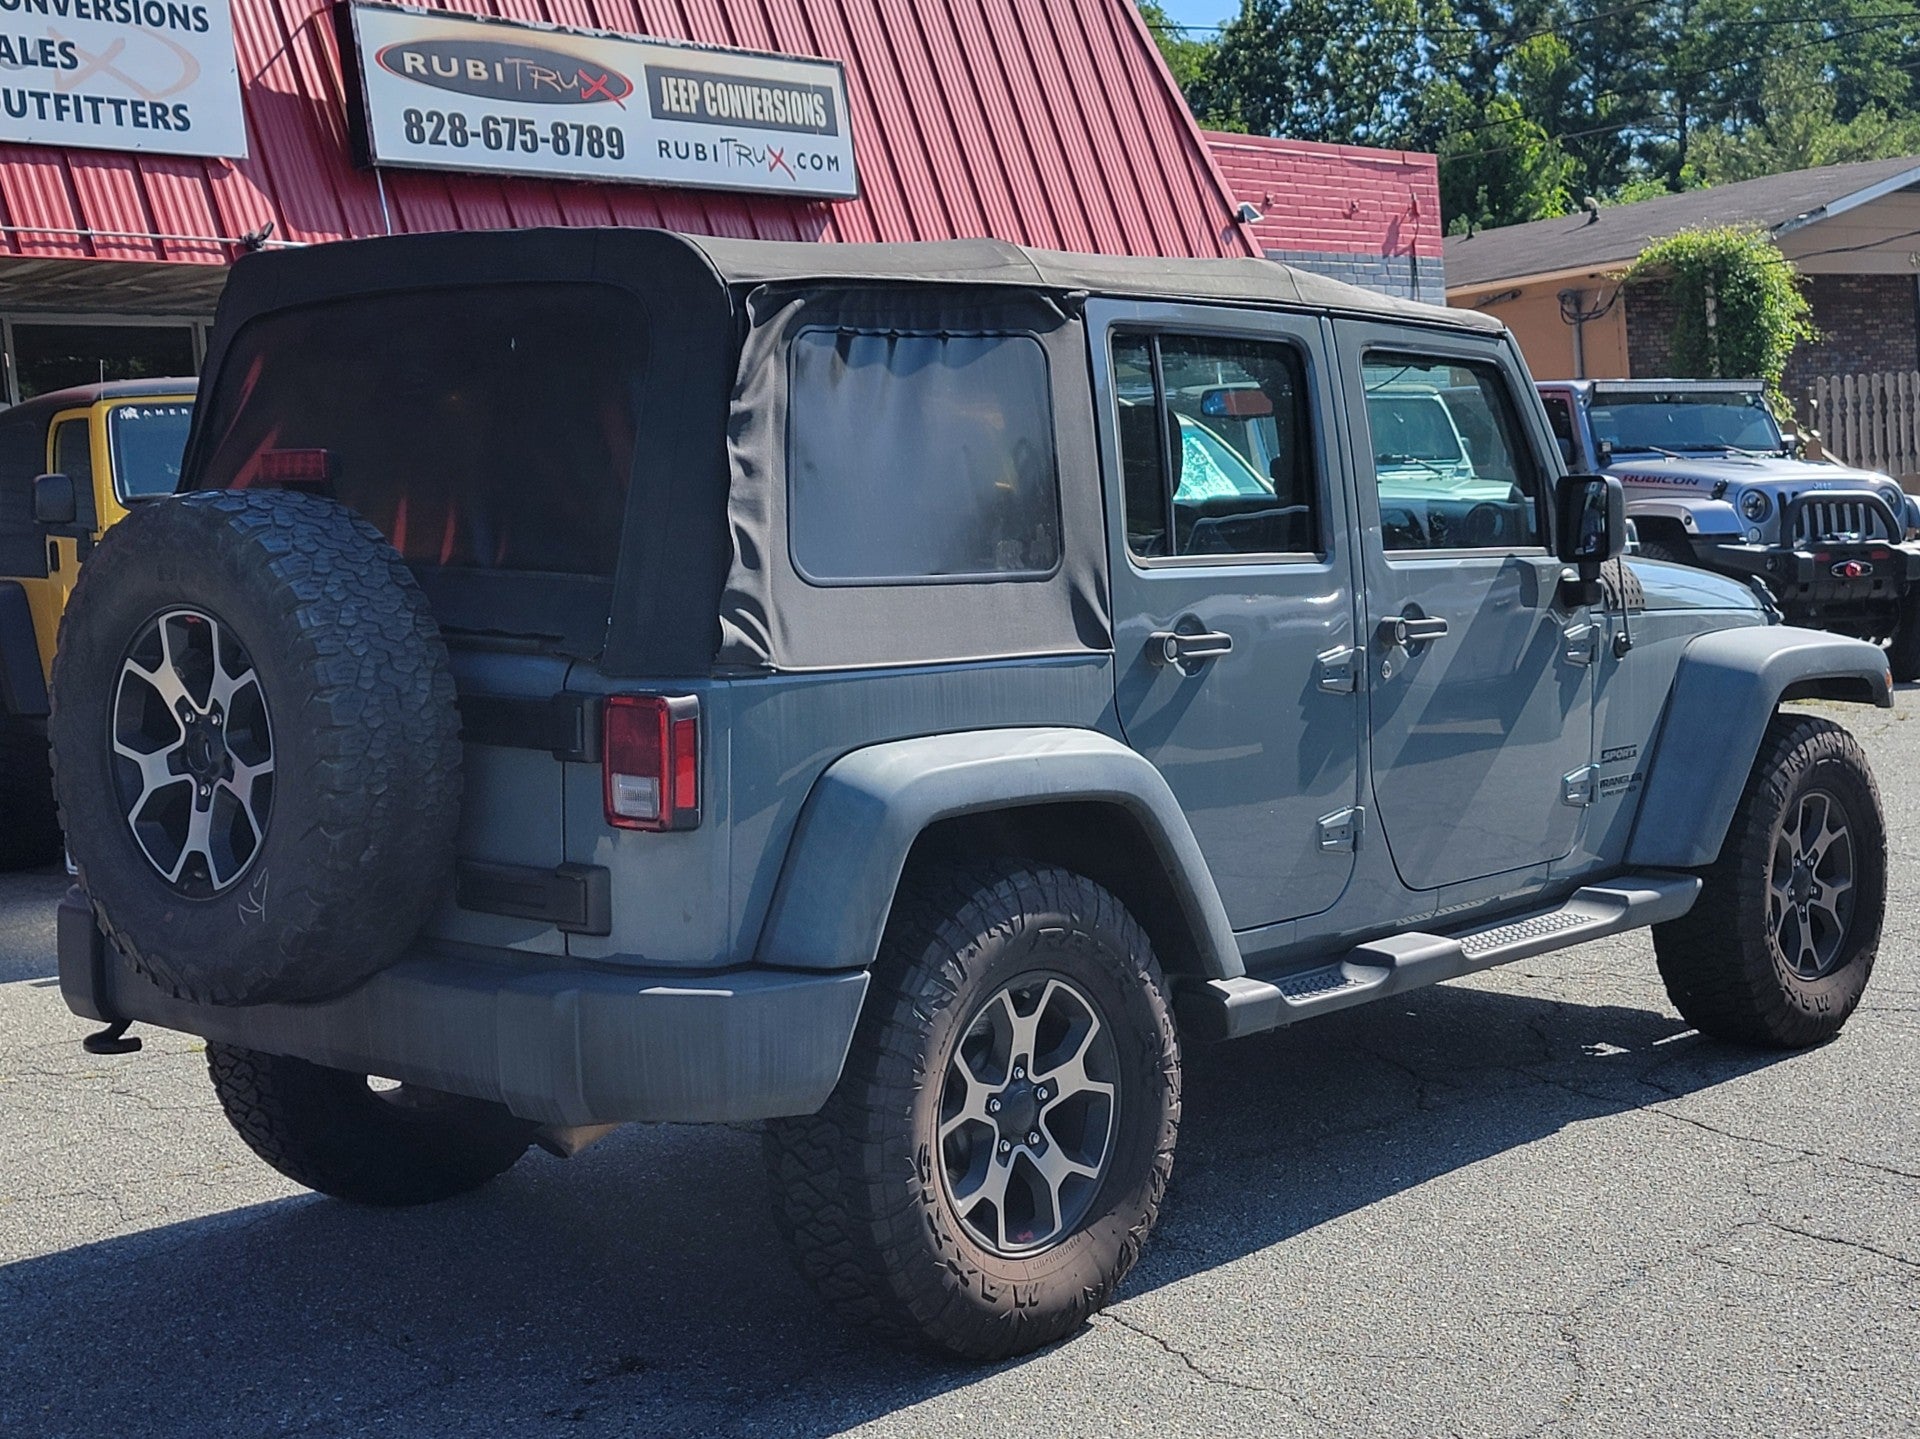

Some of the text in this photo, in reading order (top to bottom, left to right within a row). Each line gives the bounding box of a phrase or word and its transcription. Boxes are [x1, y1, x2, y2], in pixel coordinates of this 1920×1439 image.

[2, 88, 191, 132] UTFITTERS
[660, 76, 827, 128] JEEP CONVERSIONS
[403, 108, 625, 160] 828-675-8789
[1623, 474, 1699, 486] RUBICON
